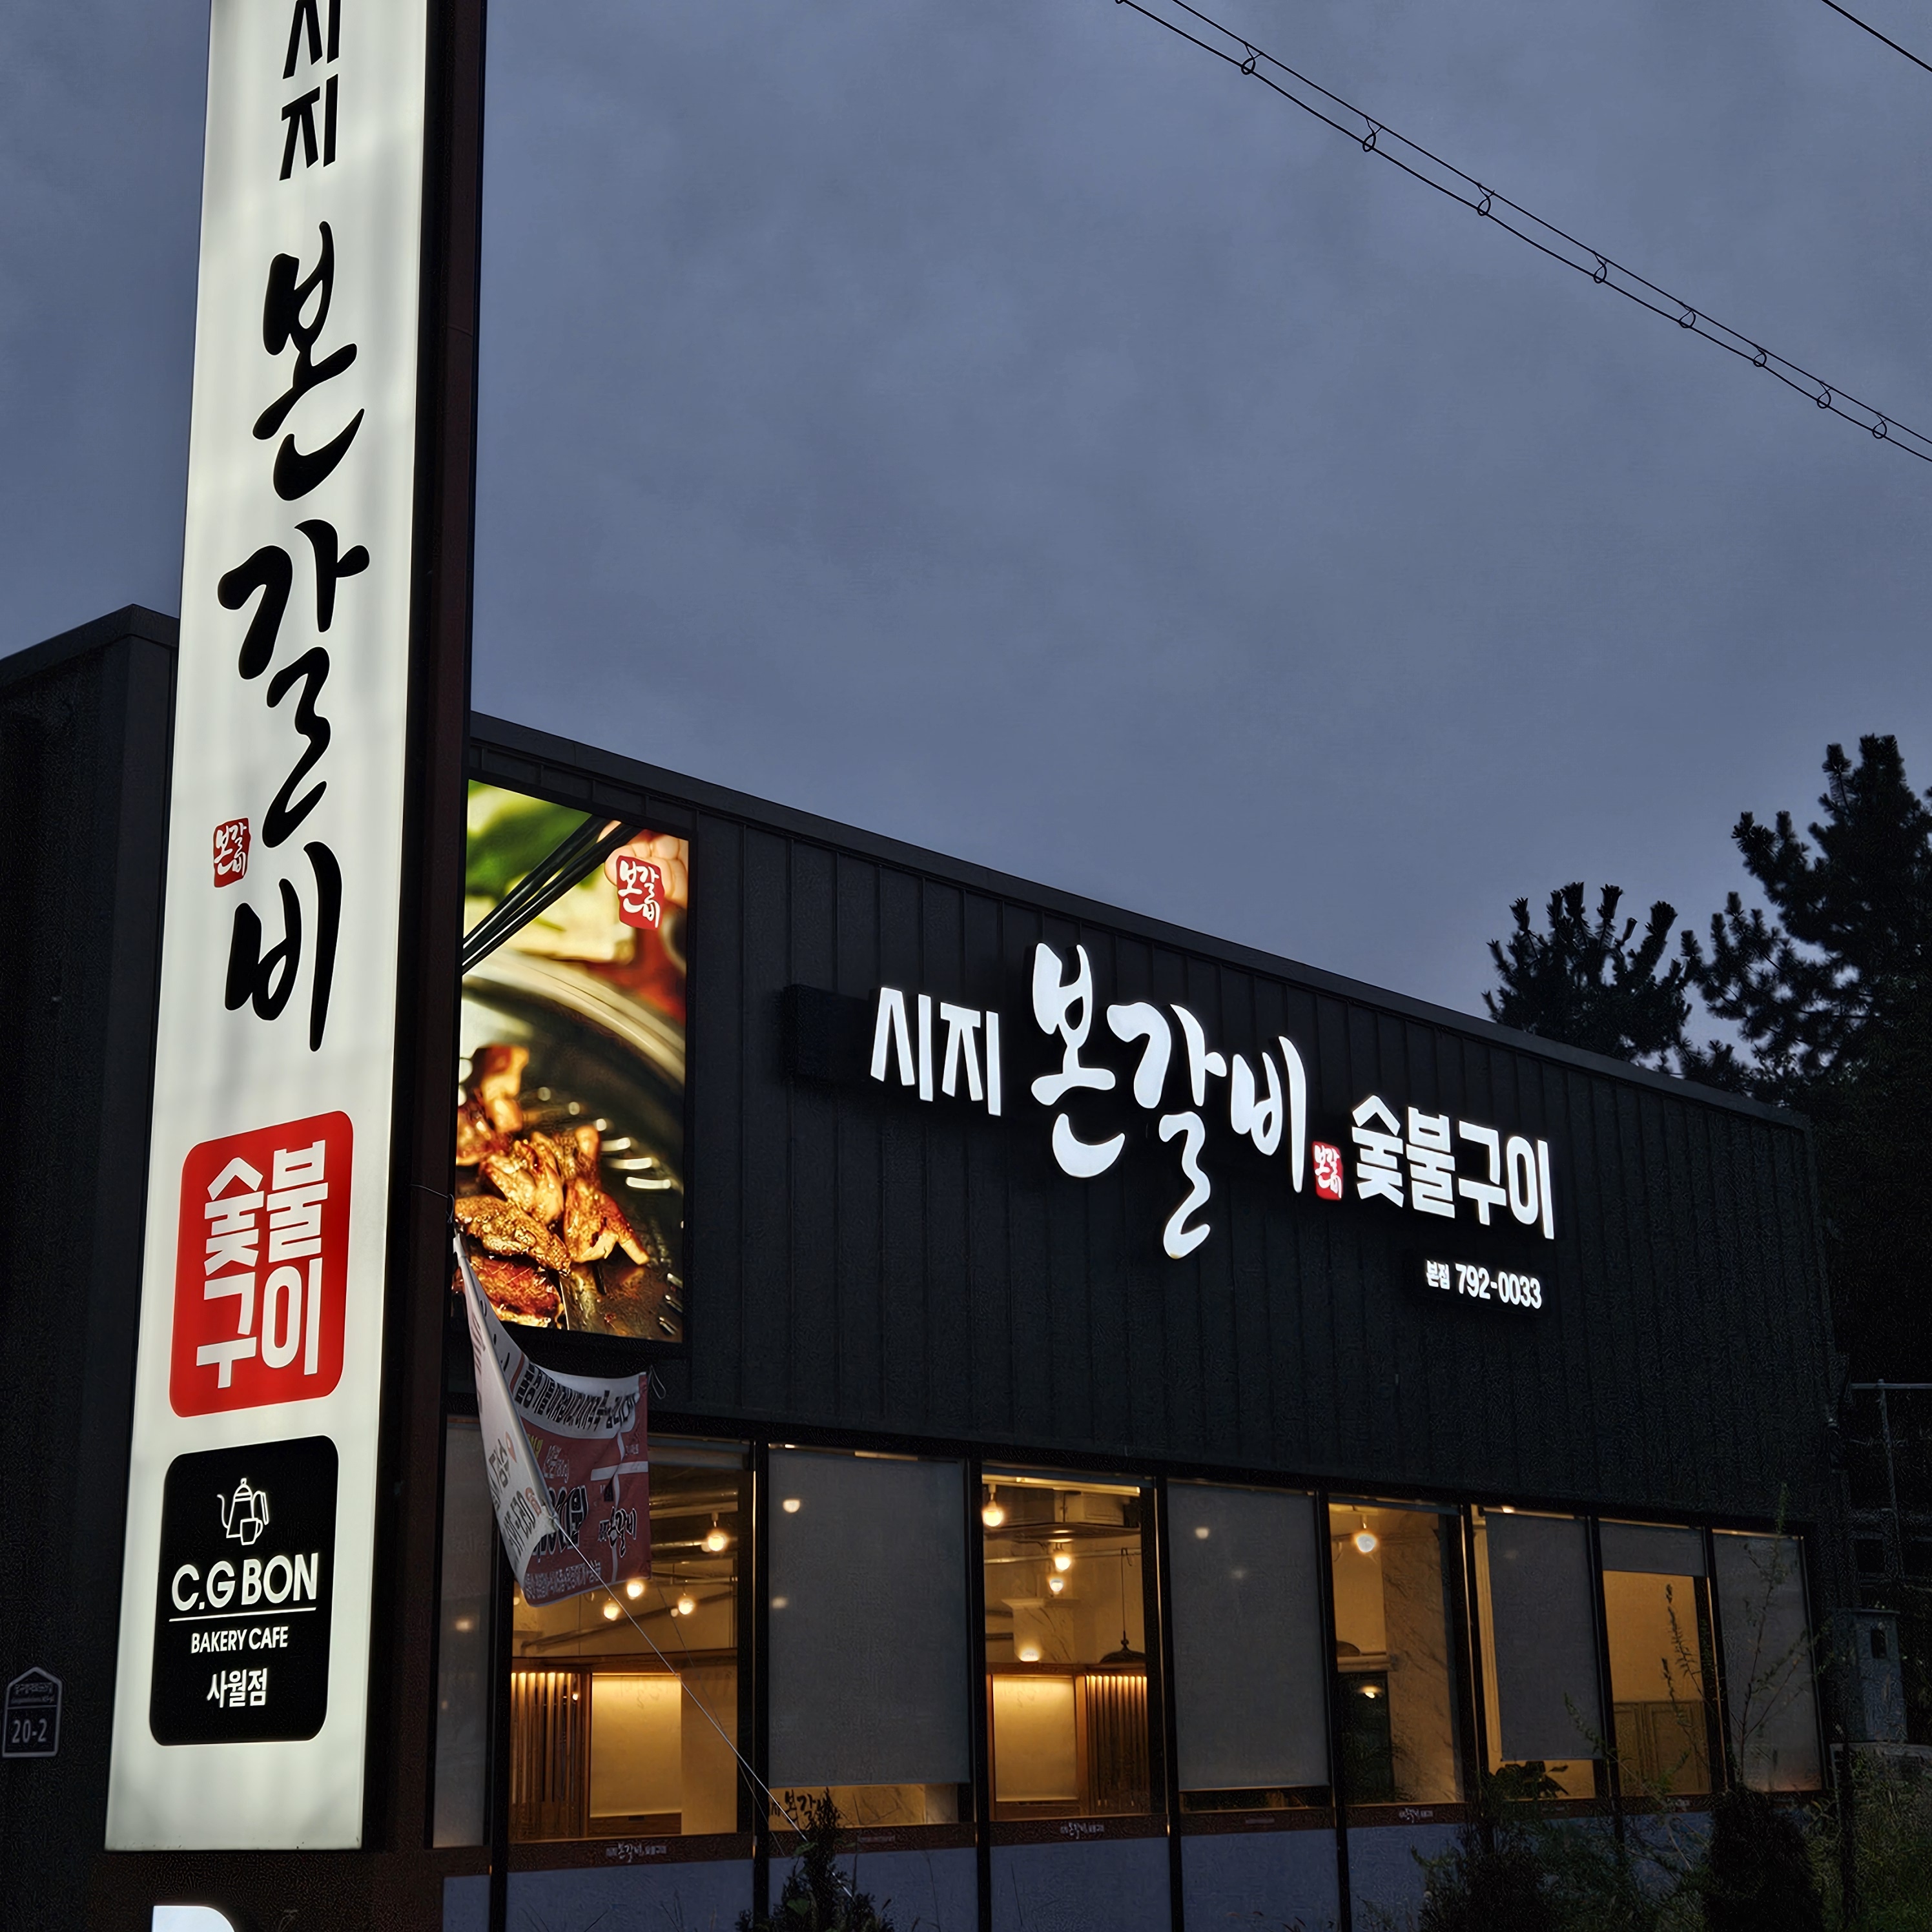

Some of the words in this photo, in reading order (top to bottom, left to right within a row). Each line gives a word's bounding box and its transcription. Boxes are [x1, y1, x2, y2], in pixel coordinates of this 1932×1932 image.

[279, 0, 341, 180] 시지
[218, 220, 370, 1053] 본갈비
[618, 860, 659, 928] 본갈비
[870, 987, 1002, 1116] 시지
[1031, 943, 1306, 1259] 본갈비
[204, 1140, 329, 1276] 숯불
[1351, 1094, 1554, 1240] 숯불구이
[196, 1257, 323, 1389] 구이
[1426, 1260, 1450, 1290] 본점
[1455, 1263, 1542, 1309] 792-0033
[171, 1564, 235, 1612] C.G
[242, 1552, 319, 1605] BON
[191, 1630, 246, 1654] BAKERY
[248, 1626, 289, 1650] CAFE
[207, 1667, 268, 1709] 사월점
[12, 1718, 47, 1743] 20-2
